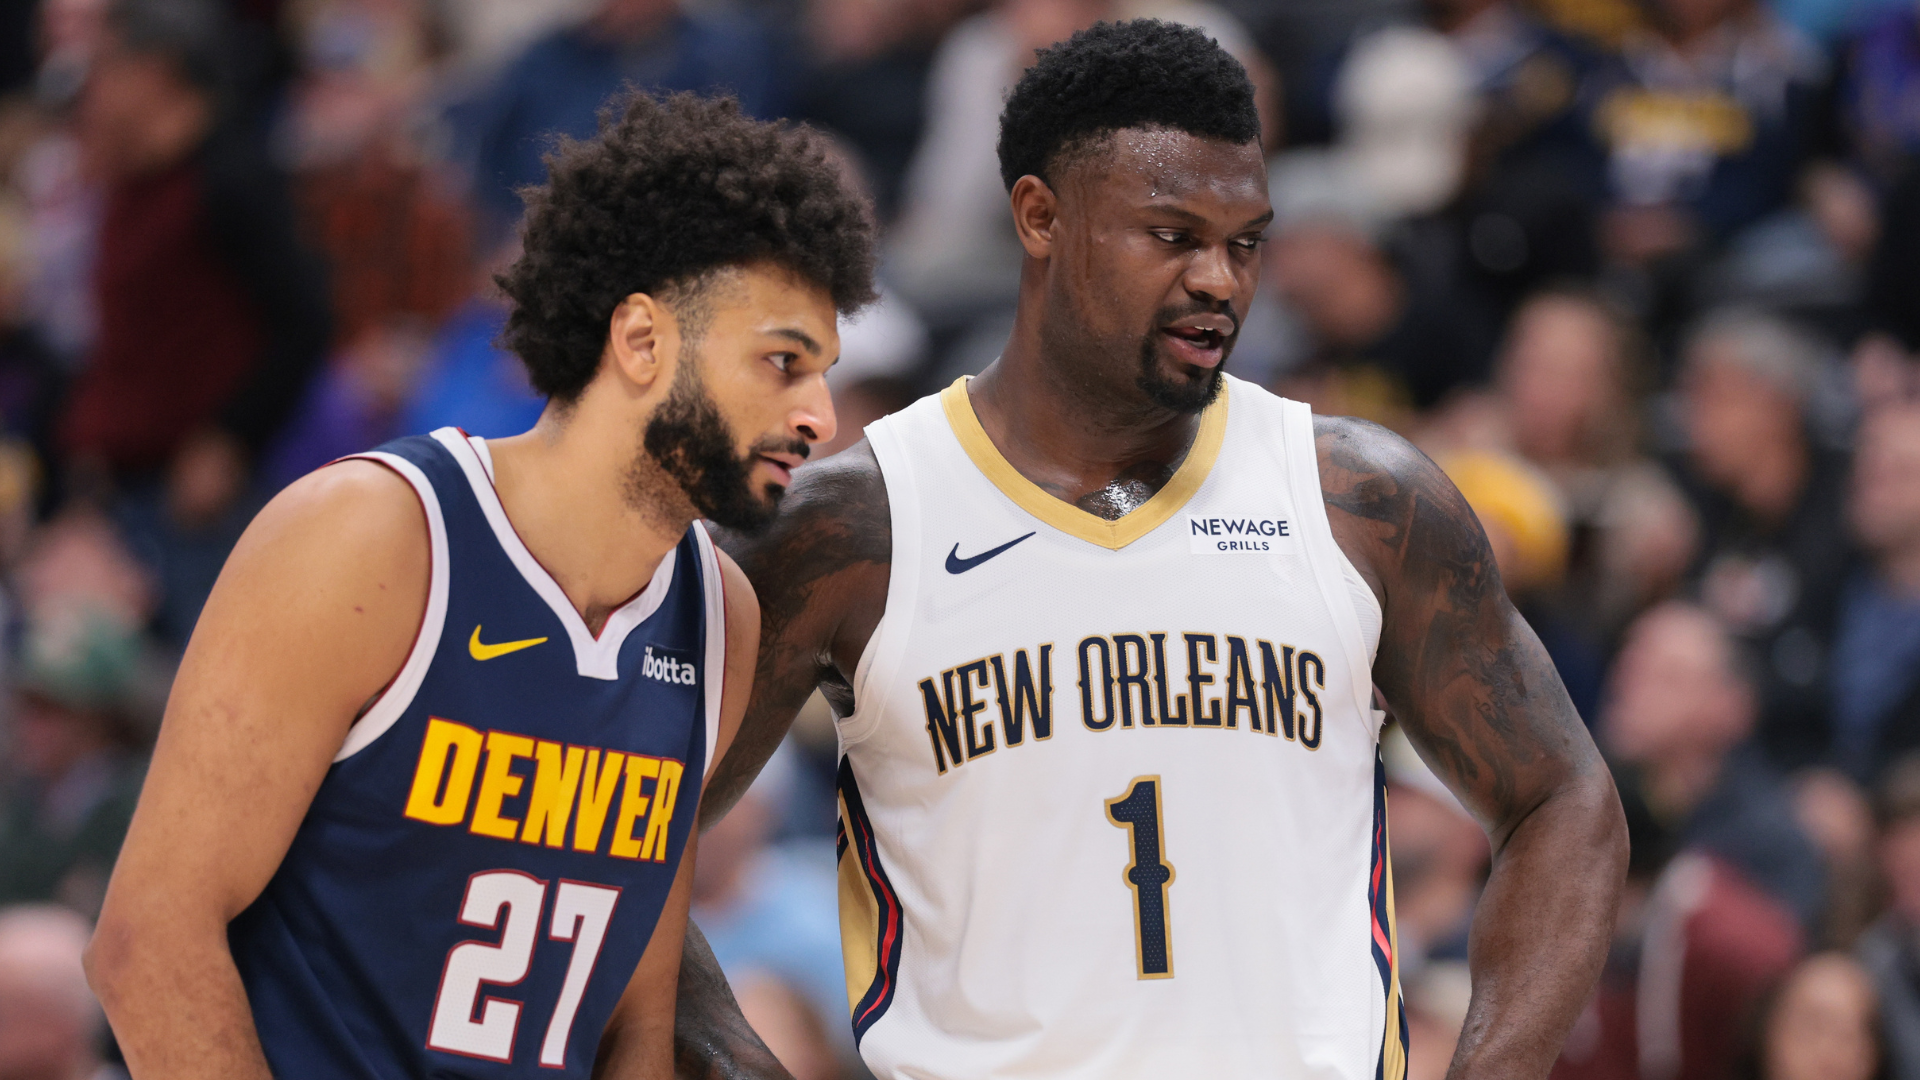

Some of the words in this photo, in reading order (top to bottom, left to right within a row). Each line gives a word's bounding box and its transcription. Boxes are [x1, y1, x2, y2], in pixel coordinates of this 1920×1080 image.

[1190, 518, 1290, 537] NEWAGE
[1216, 540, 1270, 551] GRILLS
[642, 646, 696, 685] ibotta
[917, 642, 1055, 776] NEW
[1077, 631, 1326, 751] ORLEANS
[403, 715, 685, 863] DENVER
[1104, 774, 1176, 980] 1
[425, 868, 623, 1069] 27
